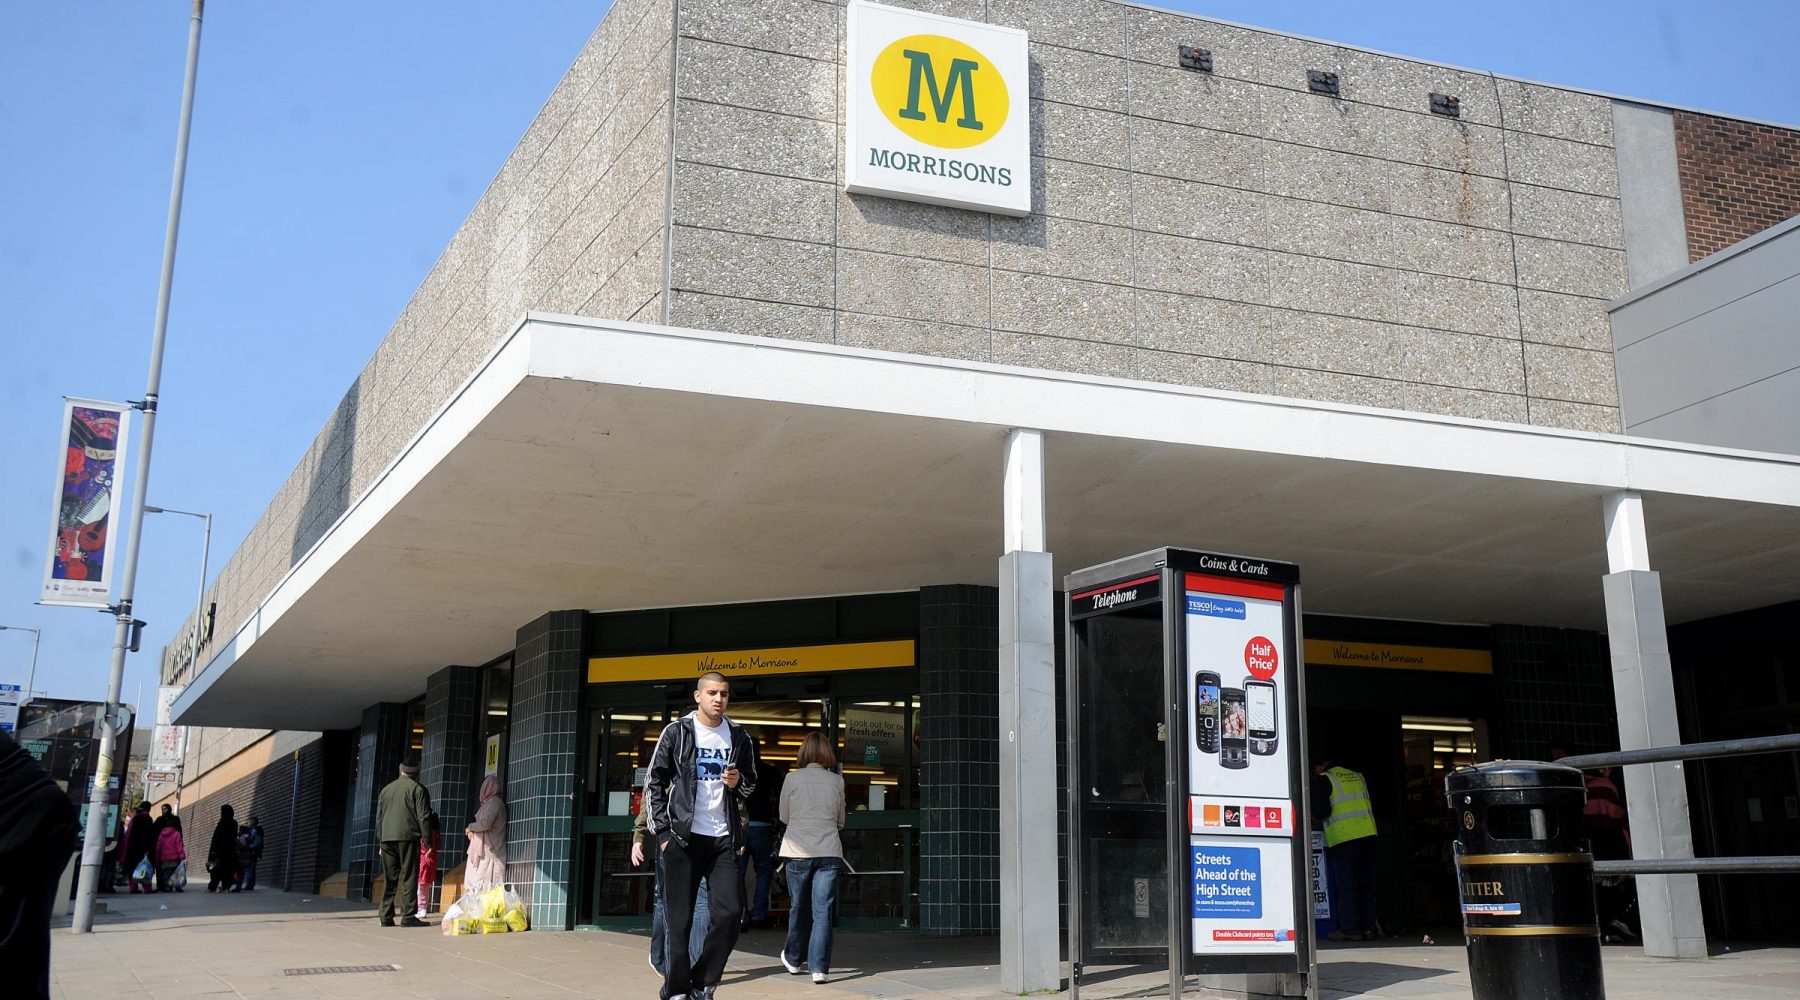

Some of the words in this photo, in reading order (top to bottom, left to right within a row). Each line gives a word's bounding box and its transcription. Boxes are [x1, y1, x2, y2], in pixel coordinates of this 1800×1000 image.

[898, 49, 983, 131] M
[868, 147, 1012, 187] MORRISONS
[1200, 555, 1228, 570] Coins
[1228, 560, 1238, 572] &
[1240, 561, 1269, 575] Cards
[1092, 589, 1137, 609] Telephone
[1188, 600, 1210, 609] TESCO
[1251, 643, 1272, 656] Half
[1332, 644, 1370, 660] Welcome
[1371, 650, 1380, 661] to
[1381, 649, 1424, 664] Morrisons
[697, 656, 738, 671] Welcome
[738, 658, 748, 669] to
[749, 656, 798, 669] Morrisons
[849, 719, 867, 728] Look
[869, 721, 882, 729] out
[884, 721, 895, 729] for
[849, 727, 870, 737] fresh
[871, 729, 896, 738] offers
[487, 743, 498, 767] M
[1195, 852, 1232, 865] Streets
[1195, 868, 1227, 880] Ahead
[1228, 868, 1239, 880] of
[1240, 869, 1256, 881] the
[1196, 883, 1219, 898] High
[1220, 884, 1251, 896] Street
[1252, 931, 1266, 939] points
